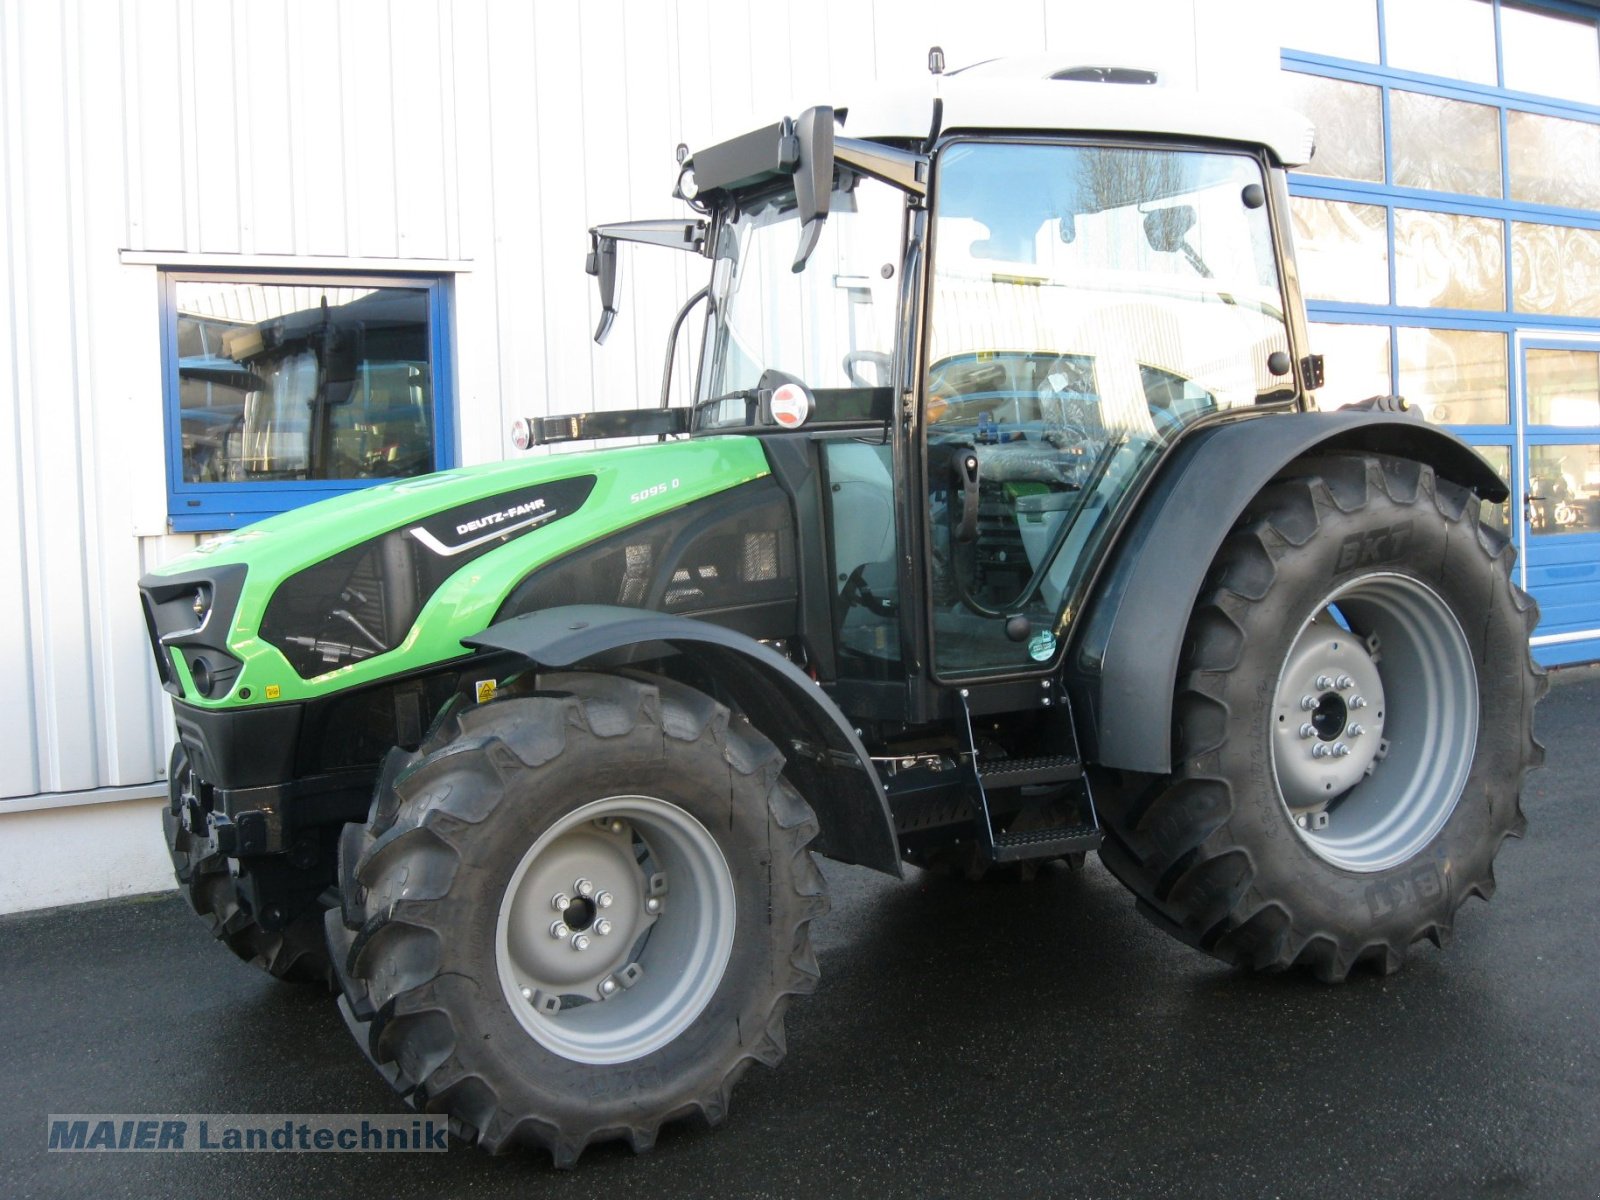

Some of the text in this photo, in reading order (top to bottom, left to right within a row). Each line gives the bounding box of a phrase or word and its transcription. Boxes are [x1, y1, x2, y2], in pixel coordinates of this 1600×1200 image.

[630, 482, 667, 504] 5095
[456, 498, 546, 535] DEUTZ-FAHR
[1337, 523, 1412, 571] BKT
